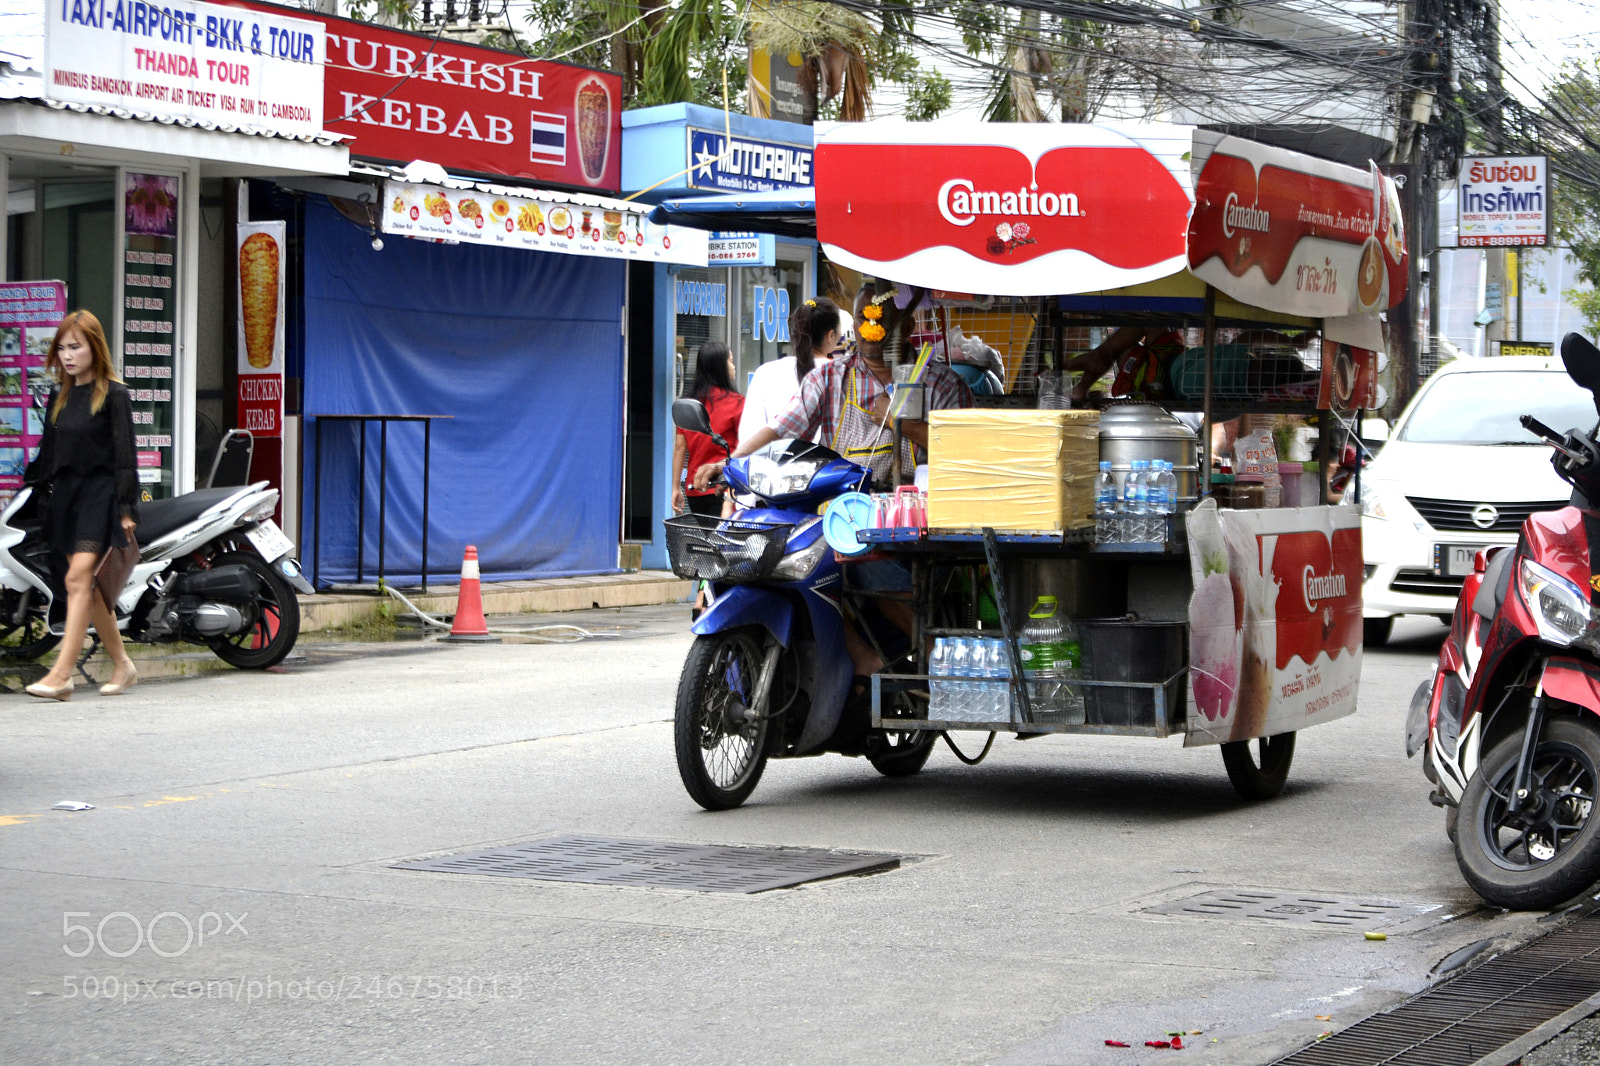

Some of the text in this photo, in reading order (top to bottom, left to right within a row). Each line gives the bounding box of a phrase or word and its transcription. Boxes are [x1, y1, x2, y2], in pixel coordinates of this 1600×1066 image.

[250, 23, 262, 56] &
[269, 26, 314, 65] TOUR
[134, 48, 250, 87] THANDA TOUR
[53, 69, 312, 123] MINIBUS BANGKOK AIRPORT AIR TICKET VISA RUN TO CAMBODIA
[339, 91, 515, 145] KEBAB
[718, 138, 812, 185] MOTORBIKE
[1470, 161, 1536, 183] รับซ่อม
[718, 176, 742, 188] Motorbike
[749, 181, 758, 190] Car
[938, 179, 1080, 226] Carnation
[1462, 184, 1543, 212] โทรศัพท์
[1223, 192, 1270, 239] Carnation
[729, 242, 757, 250] STATION
[1461, 236, 1545, 246] 081-8899175
[30, 286, 56, 298] TOUR
[677, 280, 726, 317] MOTORBIKE
[33, 312, 64, 322] AIRPORT
[754, 286, 790, 342] FOR
[240, 379, 281, 401] CHICKEN
[142, 412, 153, 424] ZOO
[246, 409, 275, 430] KEBAB
[815, 572, 840, 585] HONDA
[1303, 564, 1346, 614] Carnation
